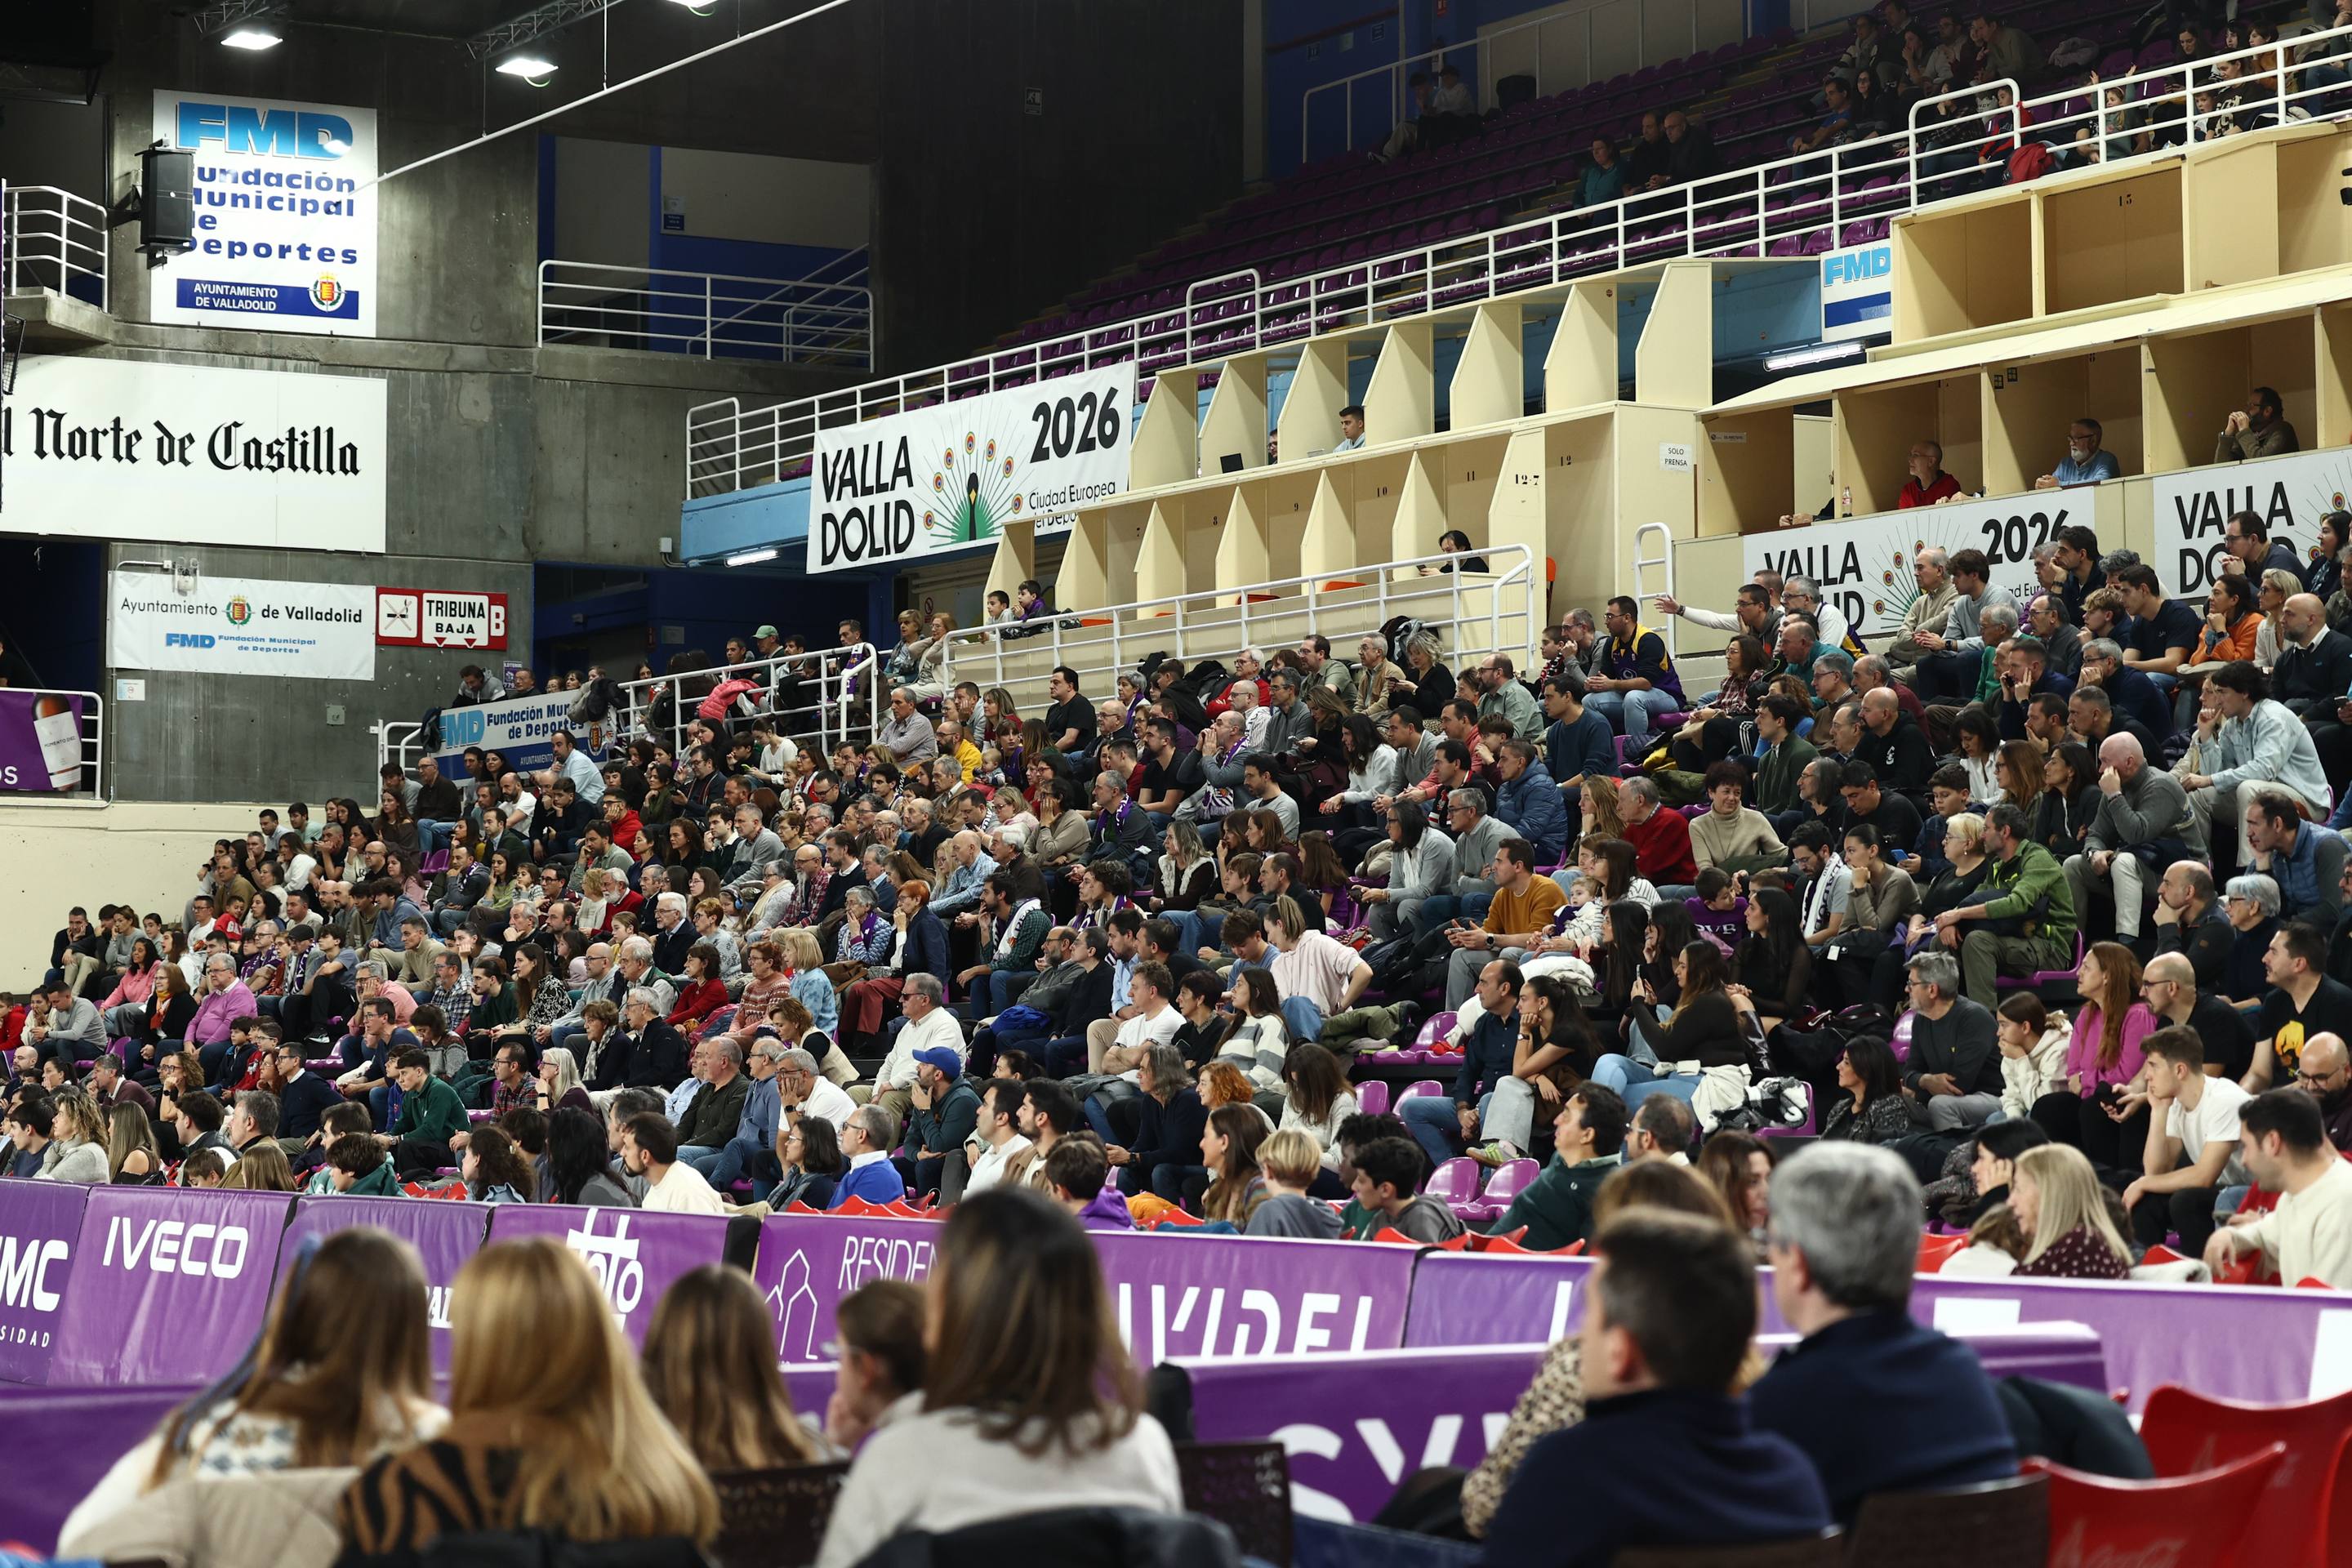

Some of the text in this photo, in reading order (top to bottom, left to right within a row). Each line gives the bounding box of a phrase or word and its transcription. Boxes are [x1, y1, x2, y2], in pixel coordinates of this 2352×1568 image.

[176, 102, 354, 162] FMD
[193, 166, 355, 193] undación
[1823, 247, 1891, 288] FMD
[194, 283, 278, 298] AYUNTAMIENTO
[195, 296, 277, 311] DE VALLADOLID
[1029, 386, 1120, 464] 2026
[28, 407, 143, 465] Norte
[153, 420, 196, 467] de
[207, 420, 362, 476] Castilla
[1668, 448, 1685, 456] SOLO
[822, 435, 914, 503] VALLA
[1664, 458, 1688, 466] PRENSA
[1029, 481, 1116, 510] Ciudad Europea
[822, 499, 915, 566] DOLID
[121, 597, 363, 624] Ayuntamiento de Valladolid
[426, 599, 485, 619] TRIBUNA
[435, 623, 475, 634] BAJA
[166, 633, 316, 649] FMD Fundación Municipal
[252, 645, 300, 654] Deportes
[486, 706, 543, 726] Fundación
[508, 726, 522, 739] de
[102, 1216, 249, 1280] IVECO
